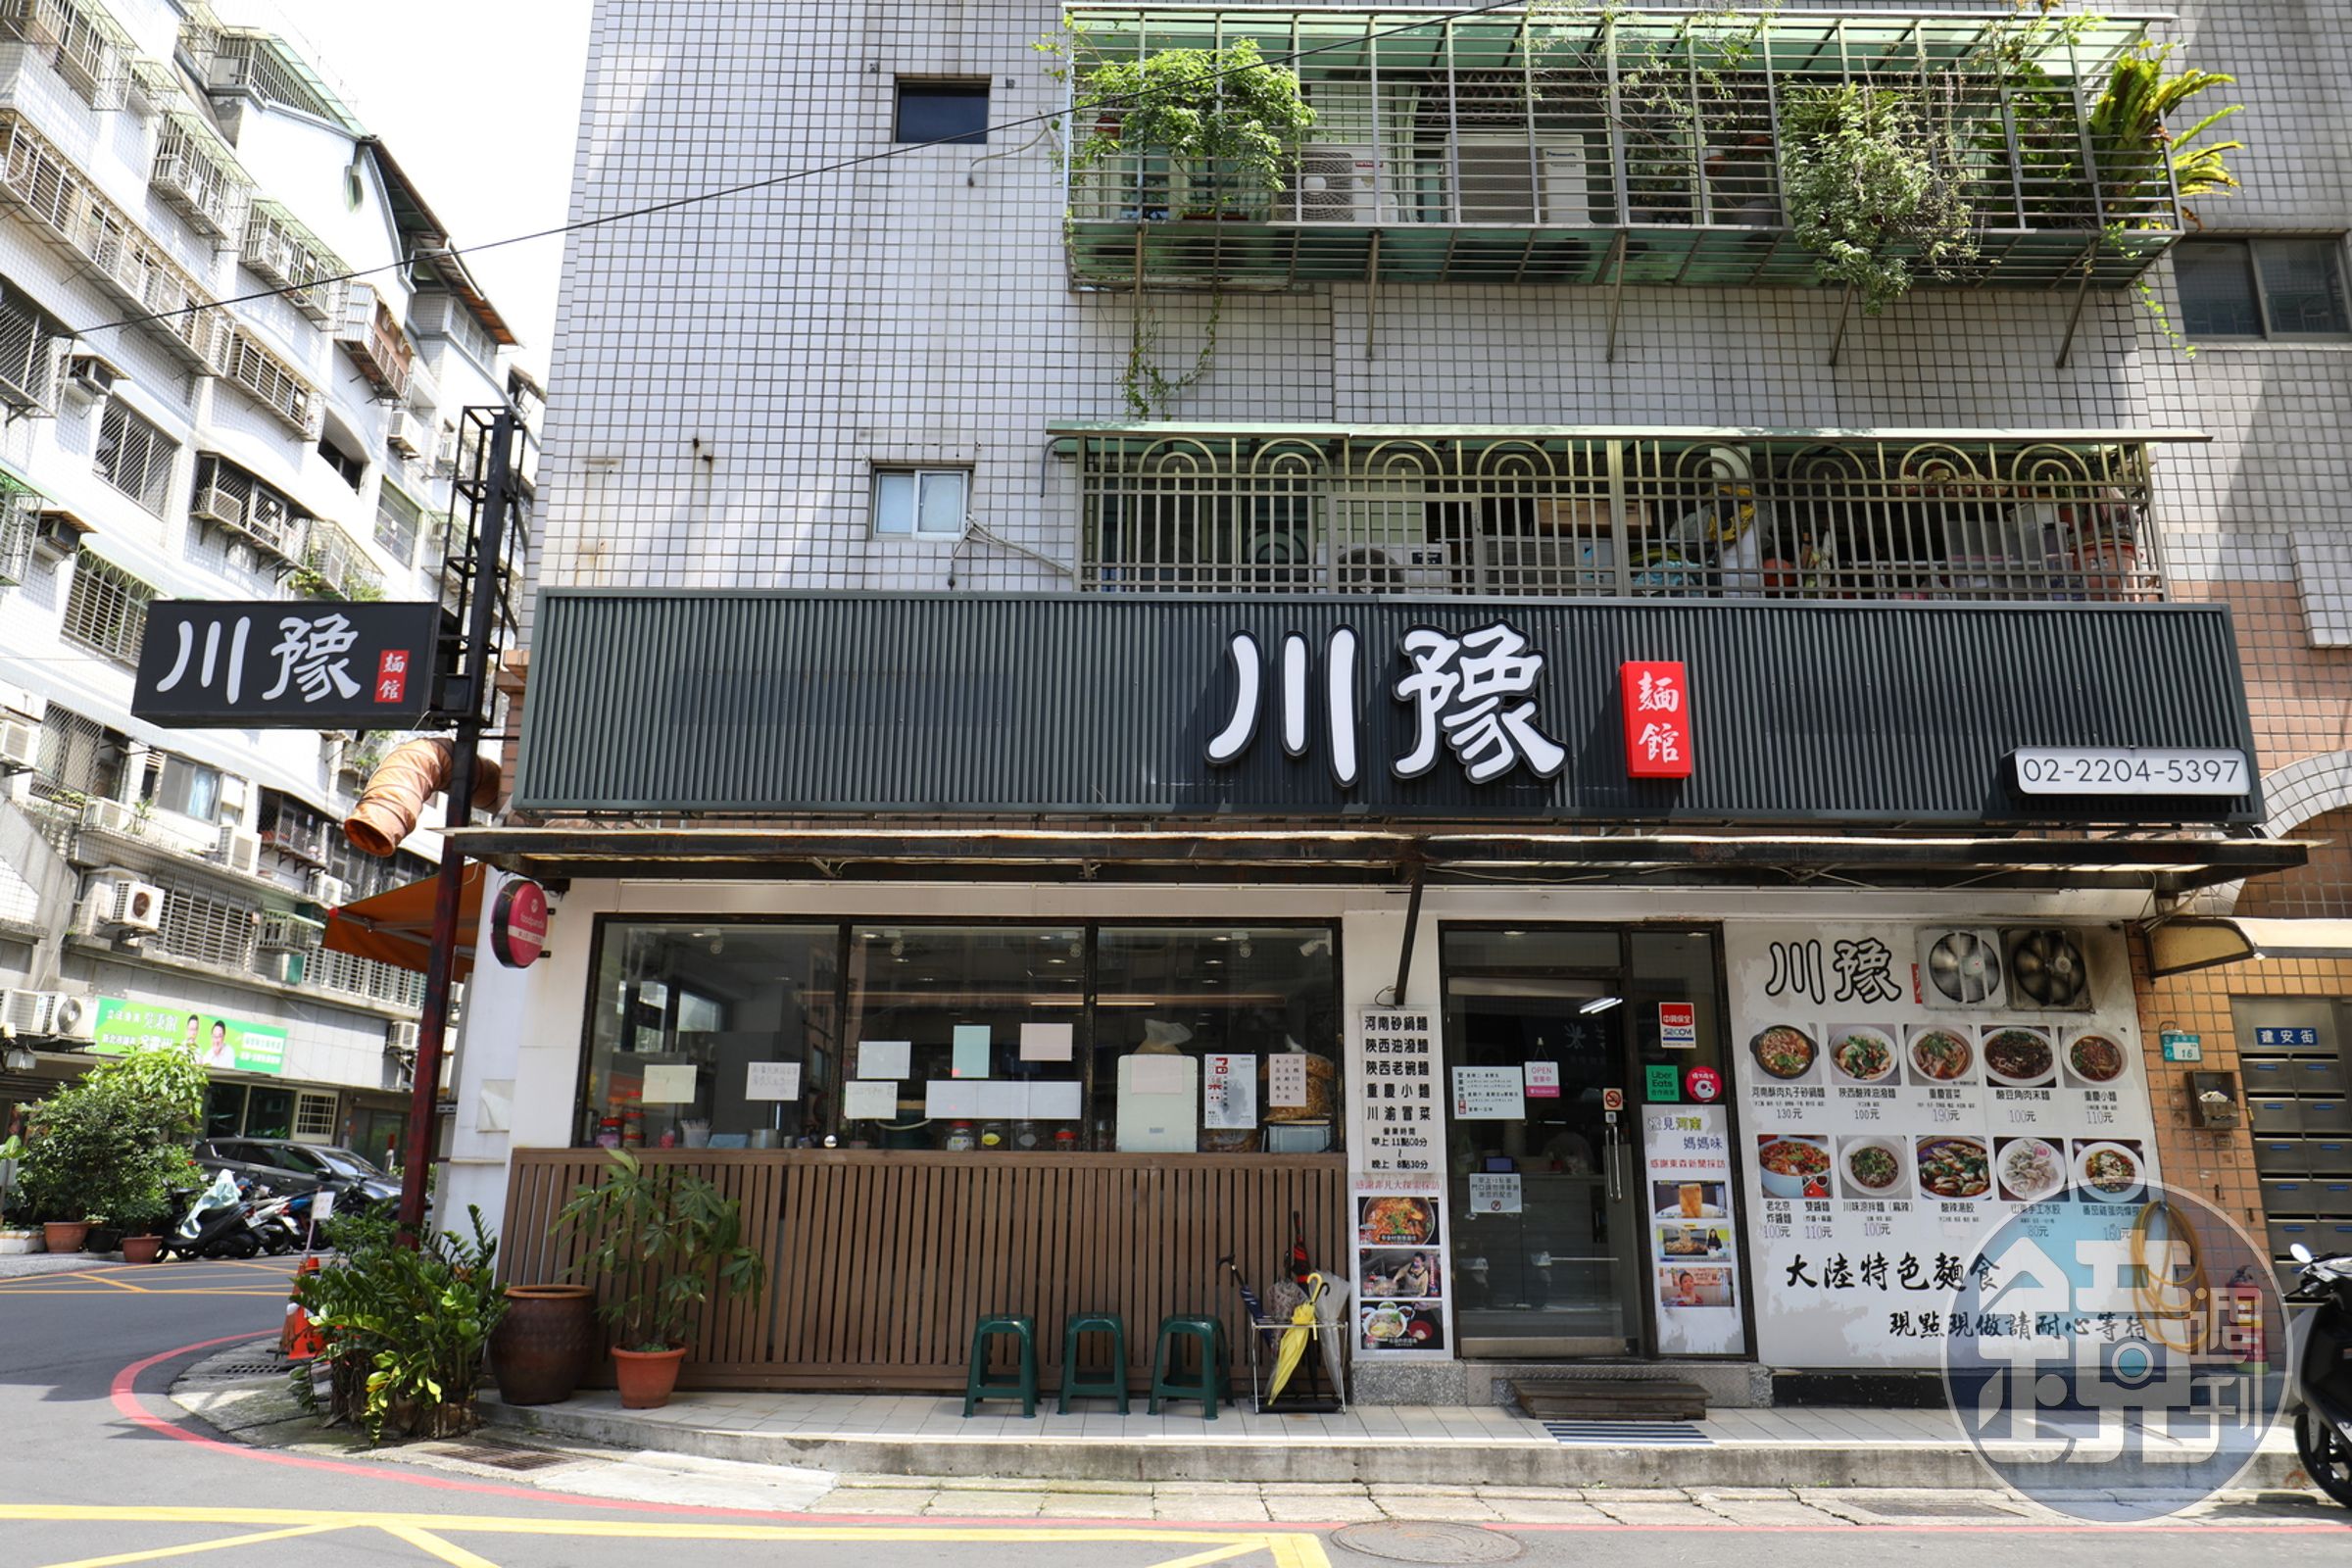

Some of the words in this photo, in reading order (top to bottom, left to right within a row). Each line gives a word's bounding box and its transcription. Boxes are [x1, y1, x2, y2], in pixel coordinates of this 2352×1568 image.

[156, 612, 361, 705] 川豫
[379, 653, 407, 700] 麵館
[1205, 620, 1568, 785] 川豫
[1638, 670, 1680, 763] 麵館
[2024, 759, 2239, 783] 02-2204-5397
[1765, 937, 1902, 1004] 川豫
[1365, 1016, 1428, 1031] 河南砂鍋麵
[2261, 1029, 2314, 1044] 建安街
[1366, 1039, 1429, 1054] 陝西油潑麵
[1366, 1061, 1430, 1075] 陝西老碗麵
[1367, 1084, 1430, 1098] 重慶小麵
[1367, 1105, 1431, 1121] 川渝冒菜
[1777, 1108, 1802, 1119] 130元
[1854, 1109, 1881, 1120] 100元
[2086, 1111, 2114, 1124] 110元
[1684, 1137, 1723, 1151] 媽媽味
[1864, 1223, 1890, 1236] 100元
[1785, 1251, 2000, 1292] 大陸特色麵食
[1889, 1310, 2148, 1342] 現點現做請耐心等待
